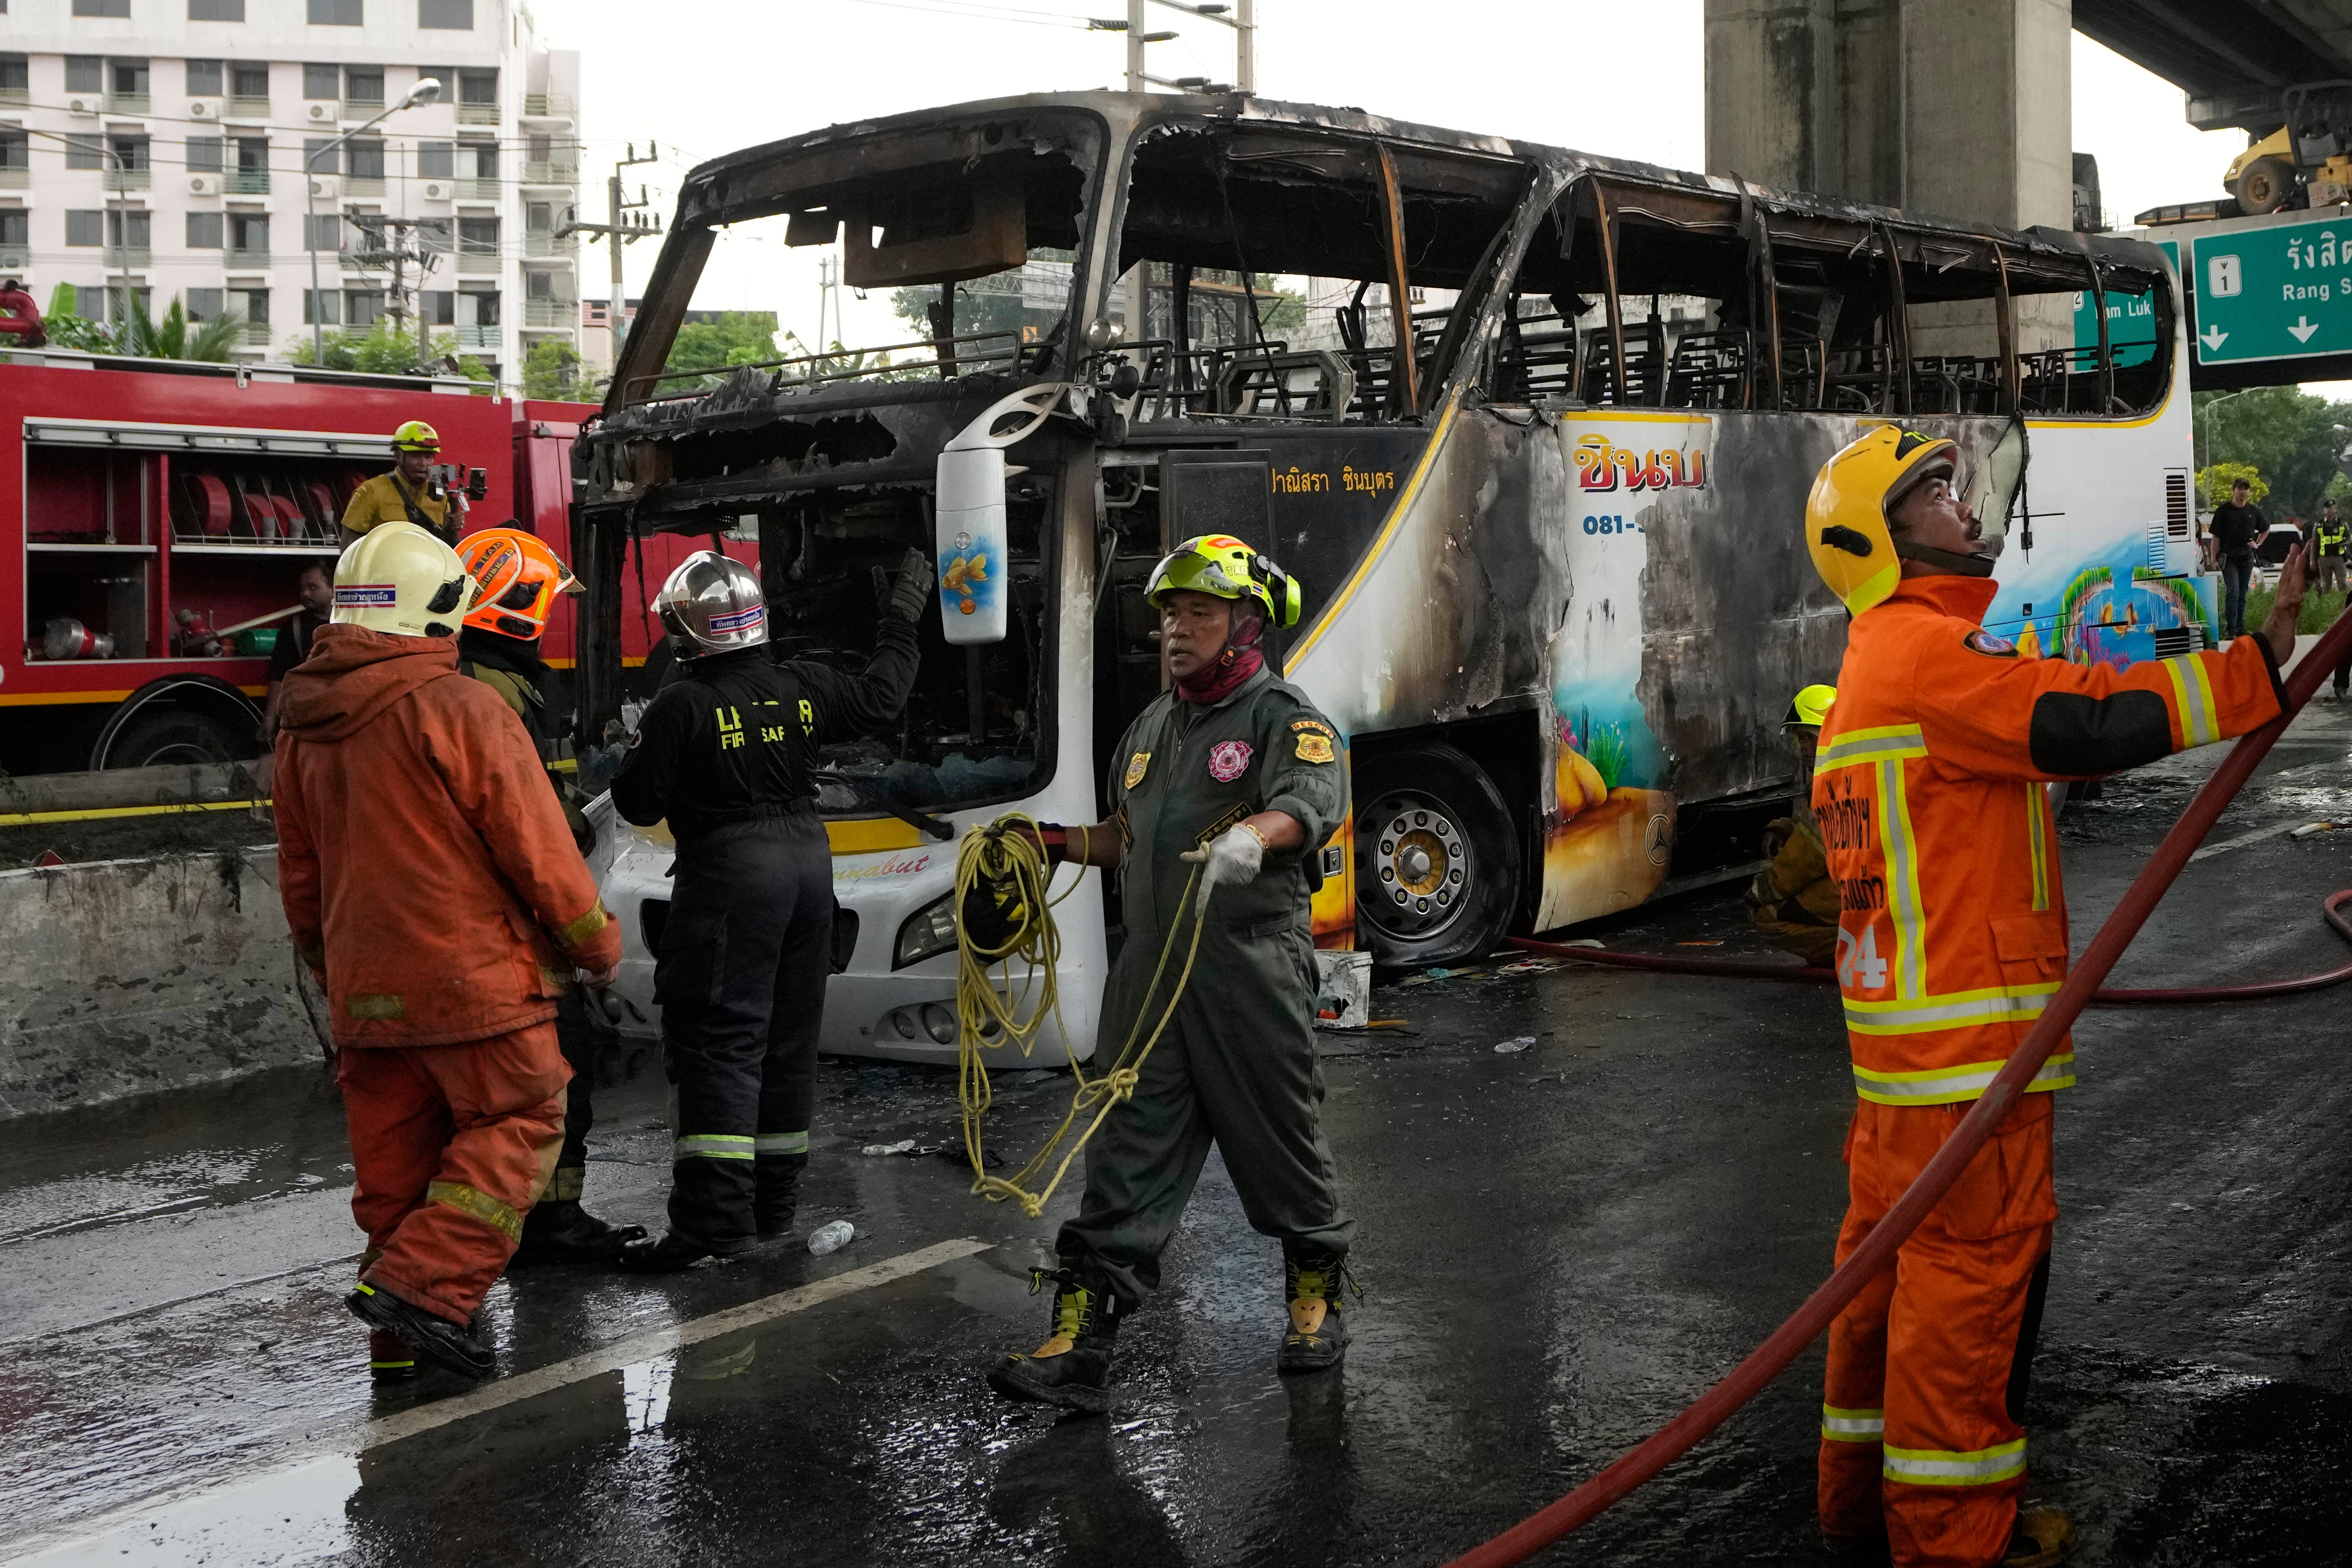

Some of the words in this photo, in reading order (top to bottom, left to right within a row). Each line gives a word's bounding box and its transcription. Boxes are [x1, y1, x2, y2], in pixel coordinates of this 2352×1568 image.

[2221, 275, 2228, 291] 1
[2283, 284, 2329, 301] Rang
[2341, 277, 2352, 294] S
[2128, 300, 2151, 317] Luk
[1342, 465, 1394, 498] ชินบุตร
[1583, 515, 1646, 535] 081-
[721, 731, 745, 750] FIR
